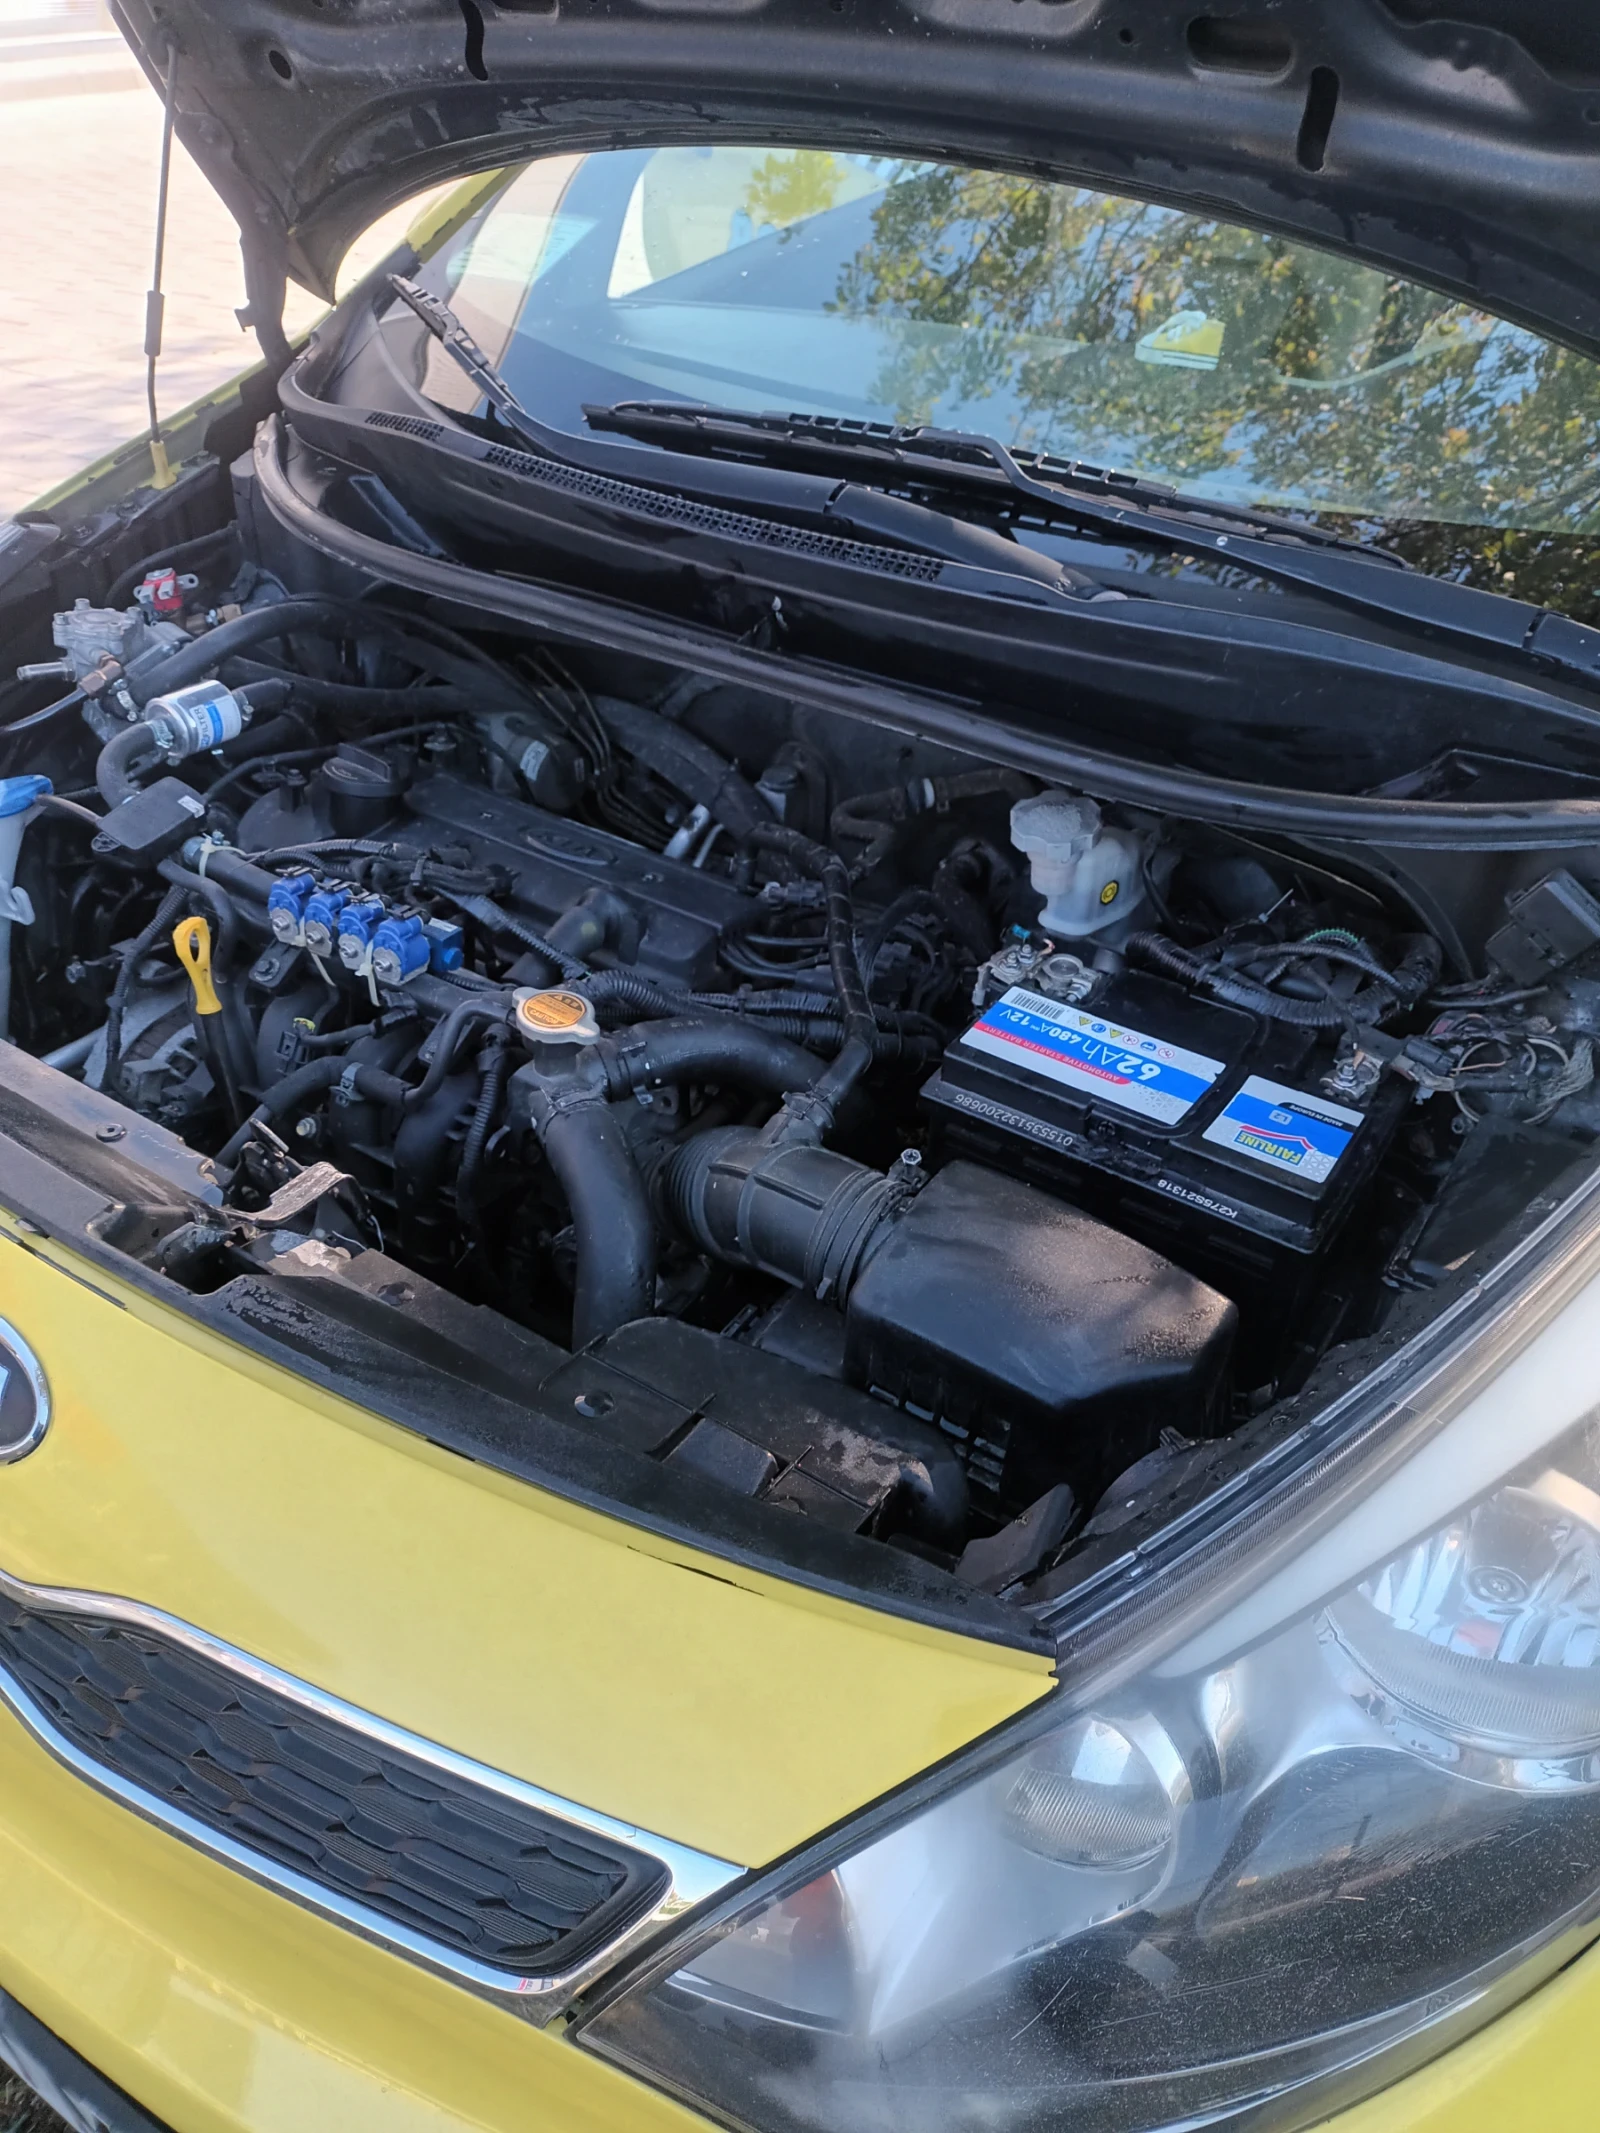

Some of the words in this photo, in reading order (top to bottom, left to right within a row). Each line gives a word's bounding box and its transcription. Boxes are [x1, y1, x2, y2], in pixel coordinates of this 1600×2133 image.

[999, 1009, 1031, 1026] 12V
[984, 1026, 1021, 1045] BATTERY
[1023, 1040, 1061, 1060] STARTER
[1082, 1039, 1161, 1081] 62Ah
[1062, 1056, 1121, 1081] AUTOMOTIVE
[953, 1094, 1073, 1147] 015535132200686
[1289, 1104, 1316, 1117] EUROPE
[1238, 1131, 1302, 1164] FAIRLINE
